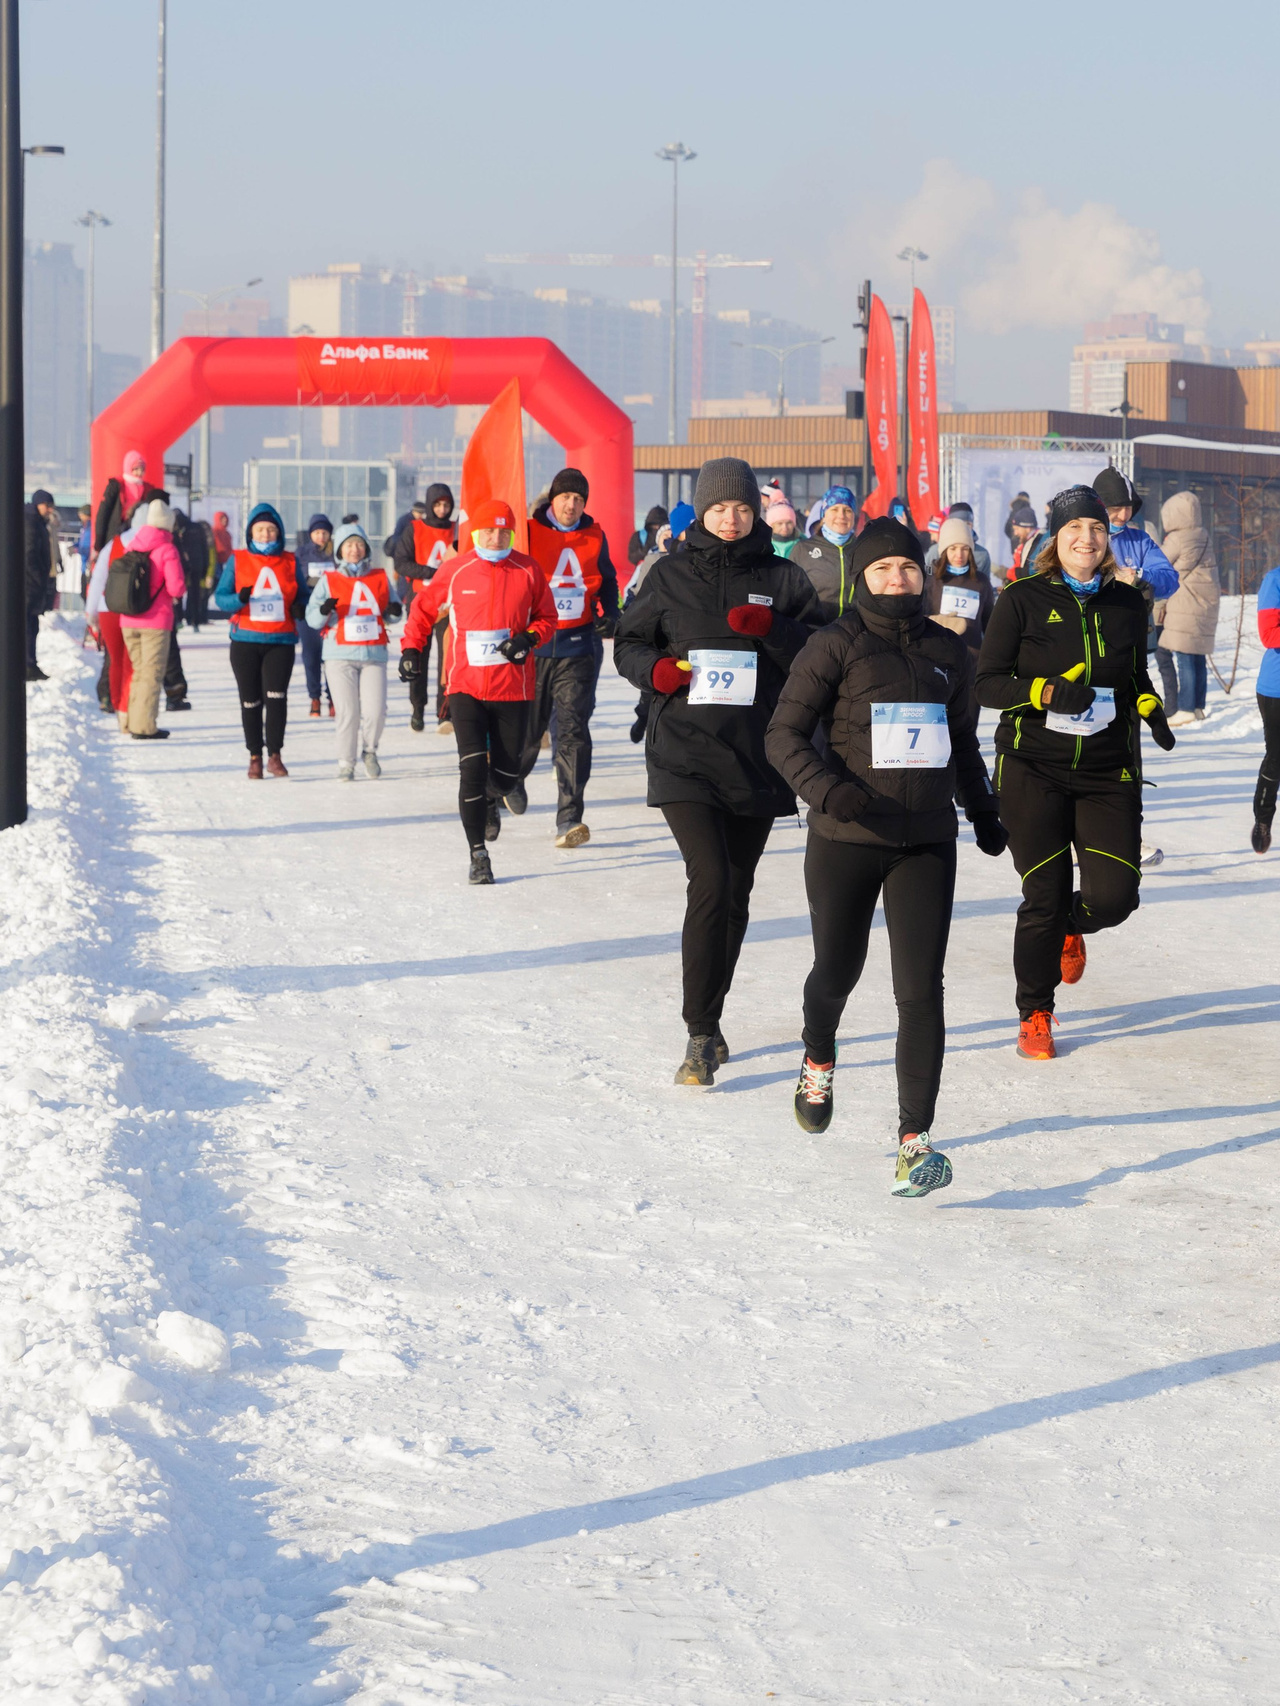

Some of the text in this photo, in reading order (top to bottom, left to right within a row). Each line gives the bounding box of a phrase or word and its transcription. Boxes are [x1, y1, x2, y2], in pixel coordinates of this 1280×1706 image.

[320, 343, 430, 363] Альфа Банк
[261, 603, 274, 613] 20
[557, 600, 572, 611] 62
[954, 598, 967, 608] 12
[356, 624, 369, 633] 85
[706, 670, 734, 690] 99
[907, 728, 921, 749] 7
